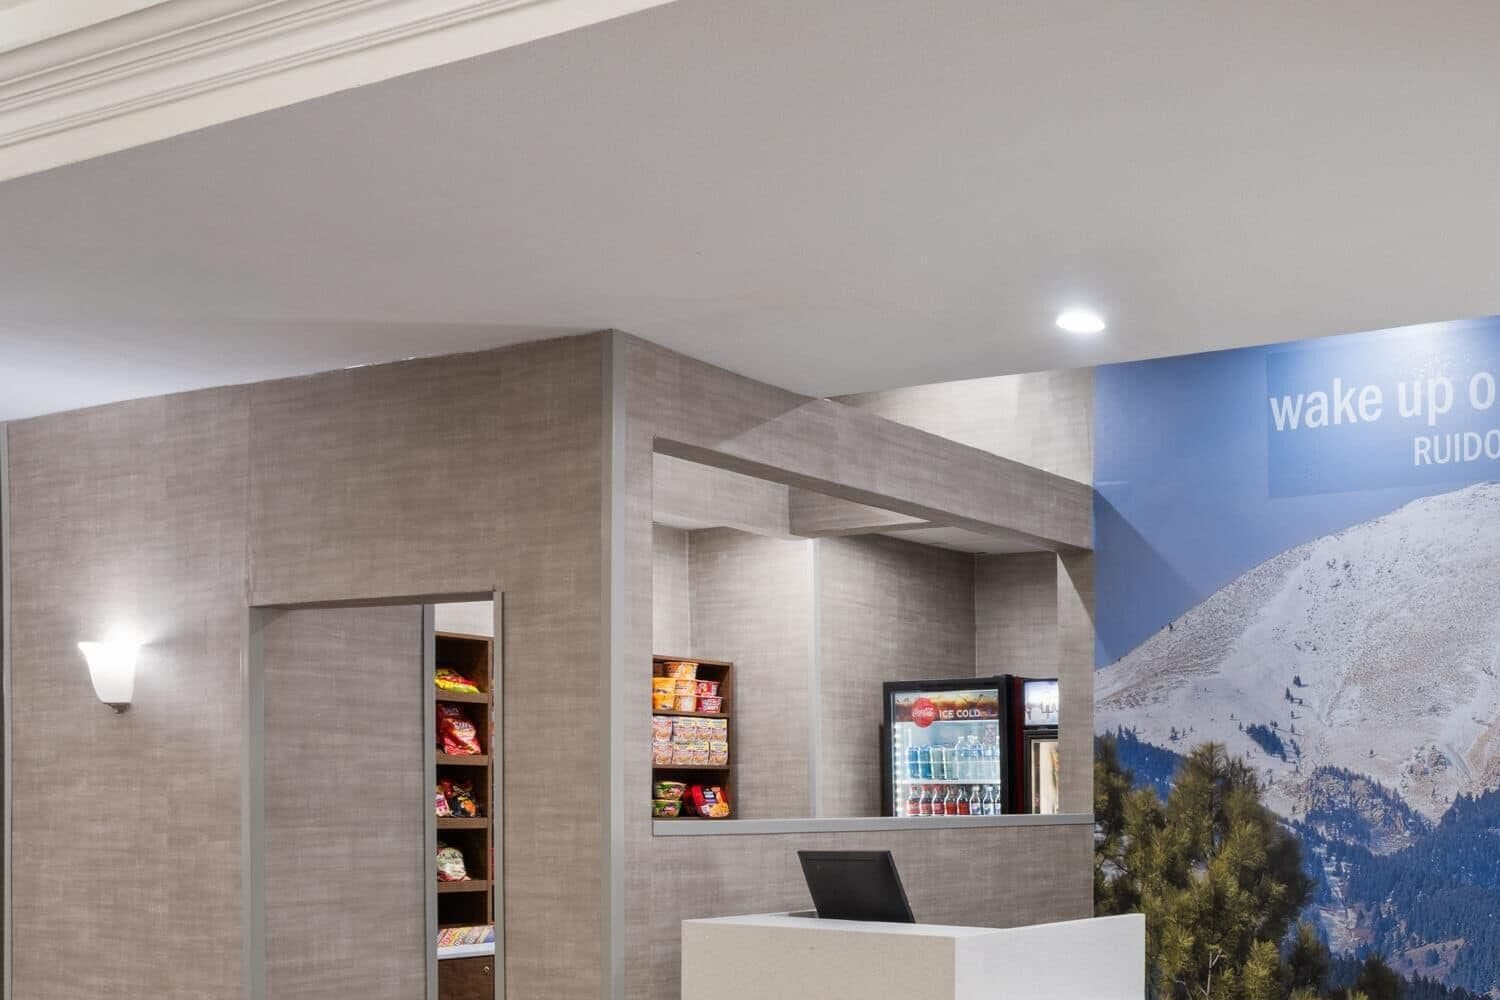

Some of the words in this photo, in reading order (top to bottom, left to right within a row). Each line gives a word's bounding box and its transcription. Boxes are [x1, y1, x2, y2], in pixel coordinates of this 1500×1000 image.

[1270, 377, 1382, 431] wake
[1398, 376, 1454, 426] up
[939, 710, 954, 719] ICE
[956, 709, 981, 718] COLD
